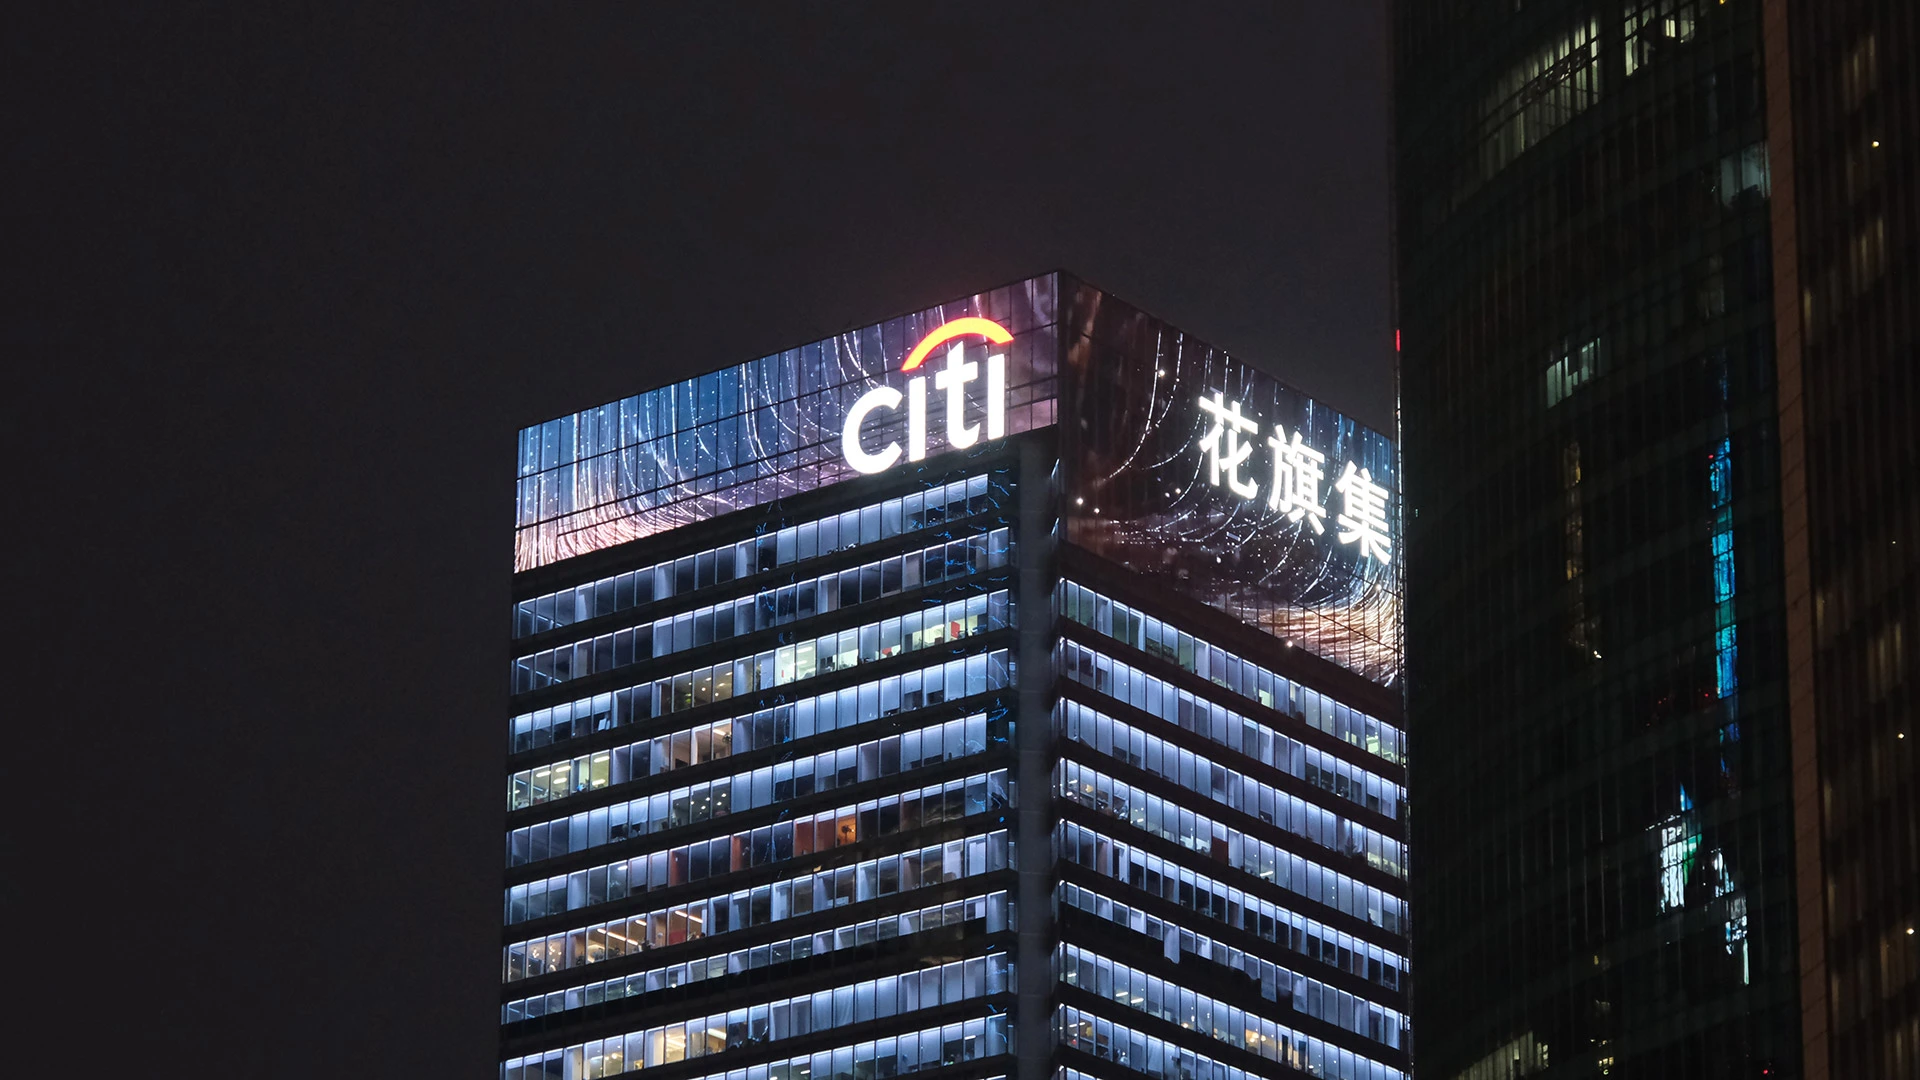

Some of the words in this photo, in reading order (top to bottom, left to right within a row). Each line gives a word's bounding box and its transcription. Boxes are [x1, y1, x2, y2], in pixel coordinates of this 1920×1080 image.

[842, 340, 1006, 475] citi
[1198, 392, 1392, 566] 花旗集
